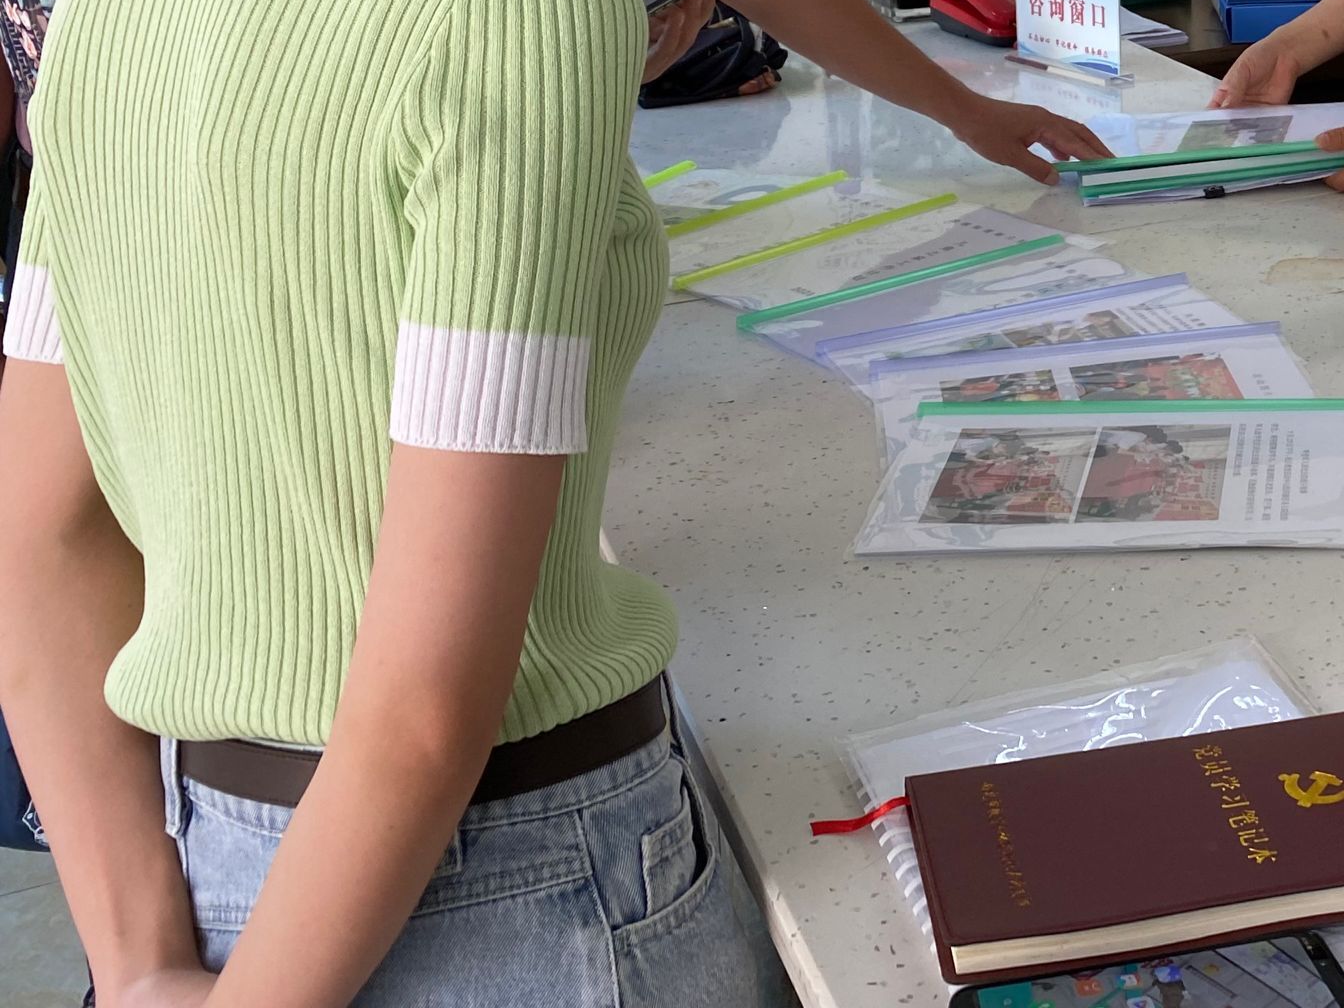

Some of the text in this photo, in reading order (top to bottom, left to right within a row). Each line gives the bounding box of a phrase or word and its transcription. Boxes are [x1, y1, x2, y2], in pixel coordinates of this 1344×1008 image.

[1192, 743, 1281, 867] 党员学习笔记本
